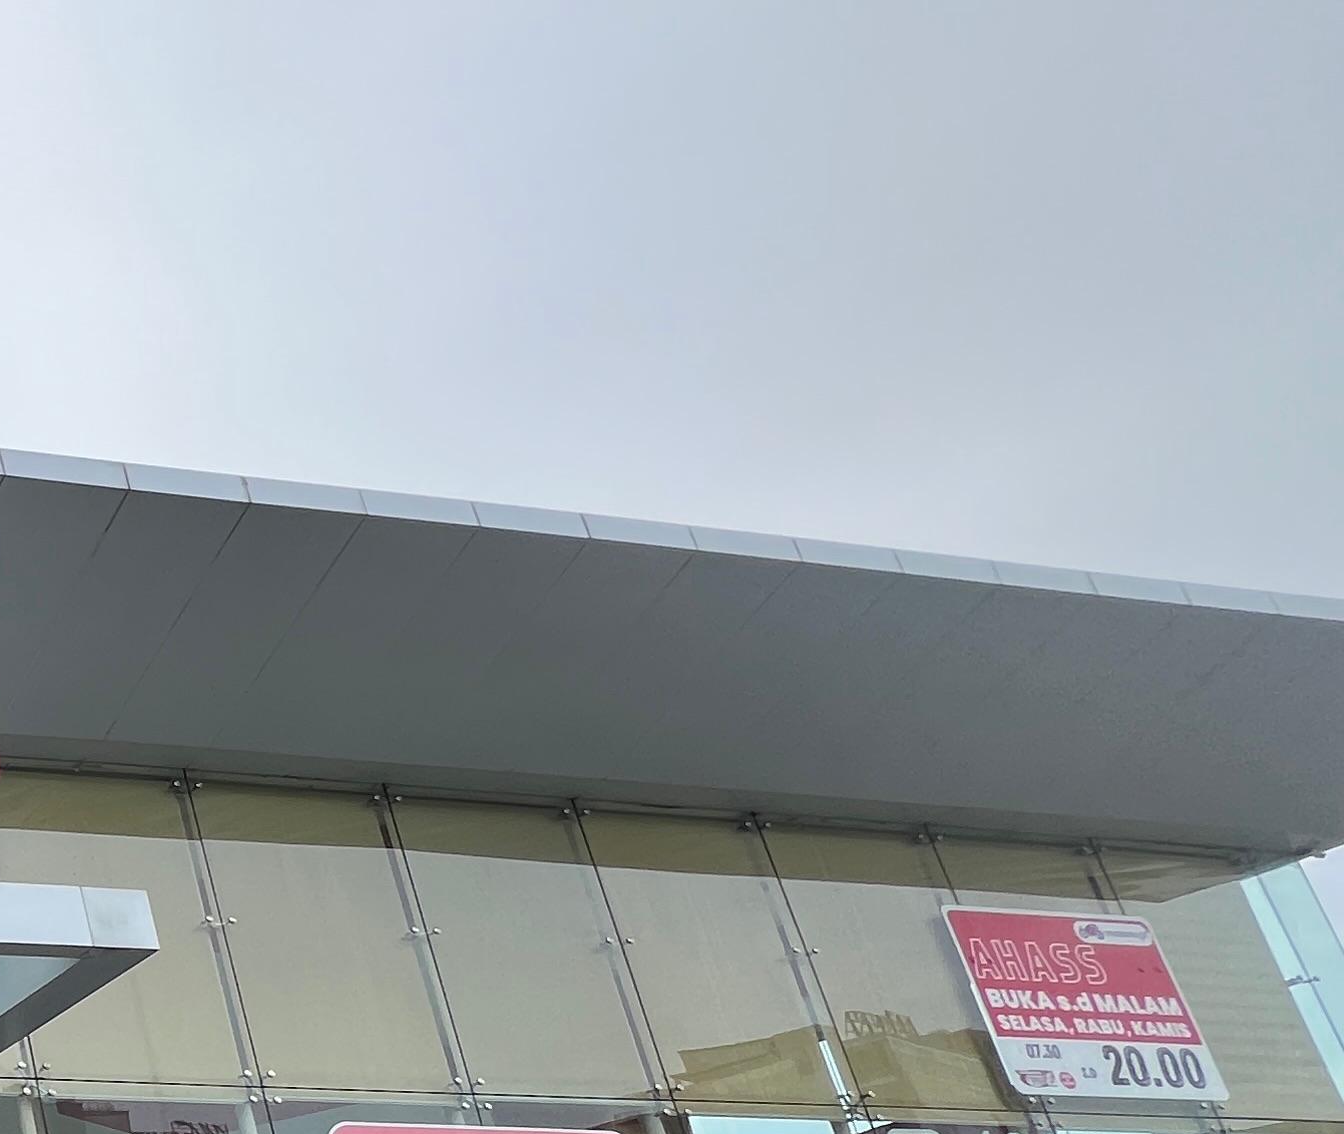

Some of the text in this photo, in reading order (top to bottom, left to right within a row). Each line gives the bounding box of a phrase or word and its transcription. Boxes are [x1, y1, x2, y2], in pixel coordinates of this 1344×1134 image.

[968, 937, 1108, 985] AHASS
[984, 987, 1056, 1011] BUKA
[1097, 993, 1184, 1017] MALAM
[999, 1014, 1074, 1036] SELASA,
[1134, 1020, 1192, 1039] KAMIS
[1025, 1043, 1062, 1060] 07.30
[1102, 1044, 1208, 1090] 20.00
